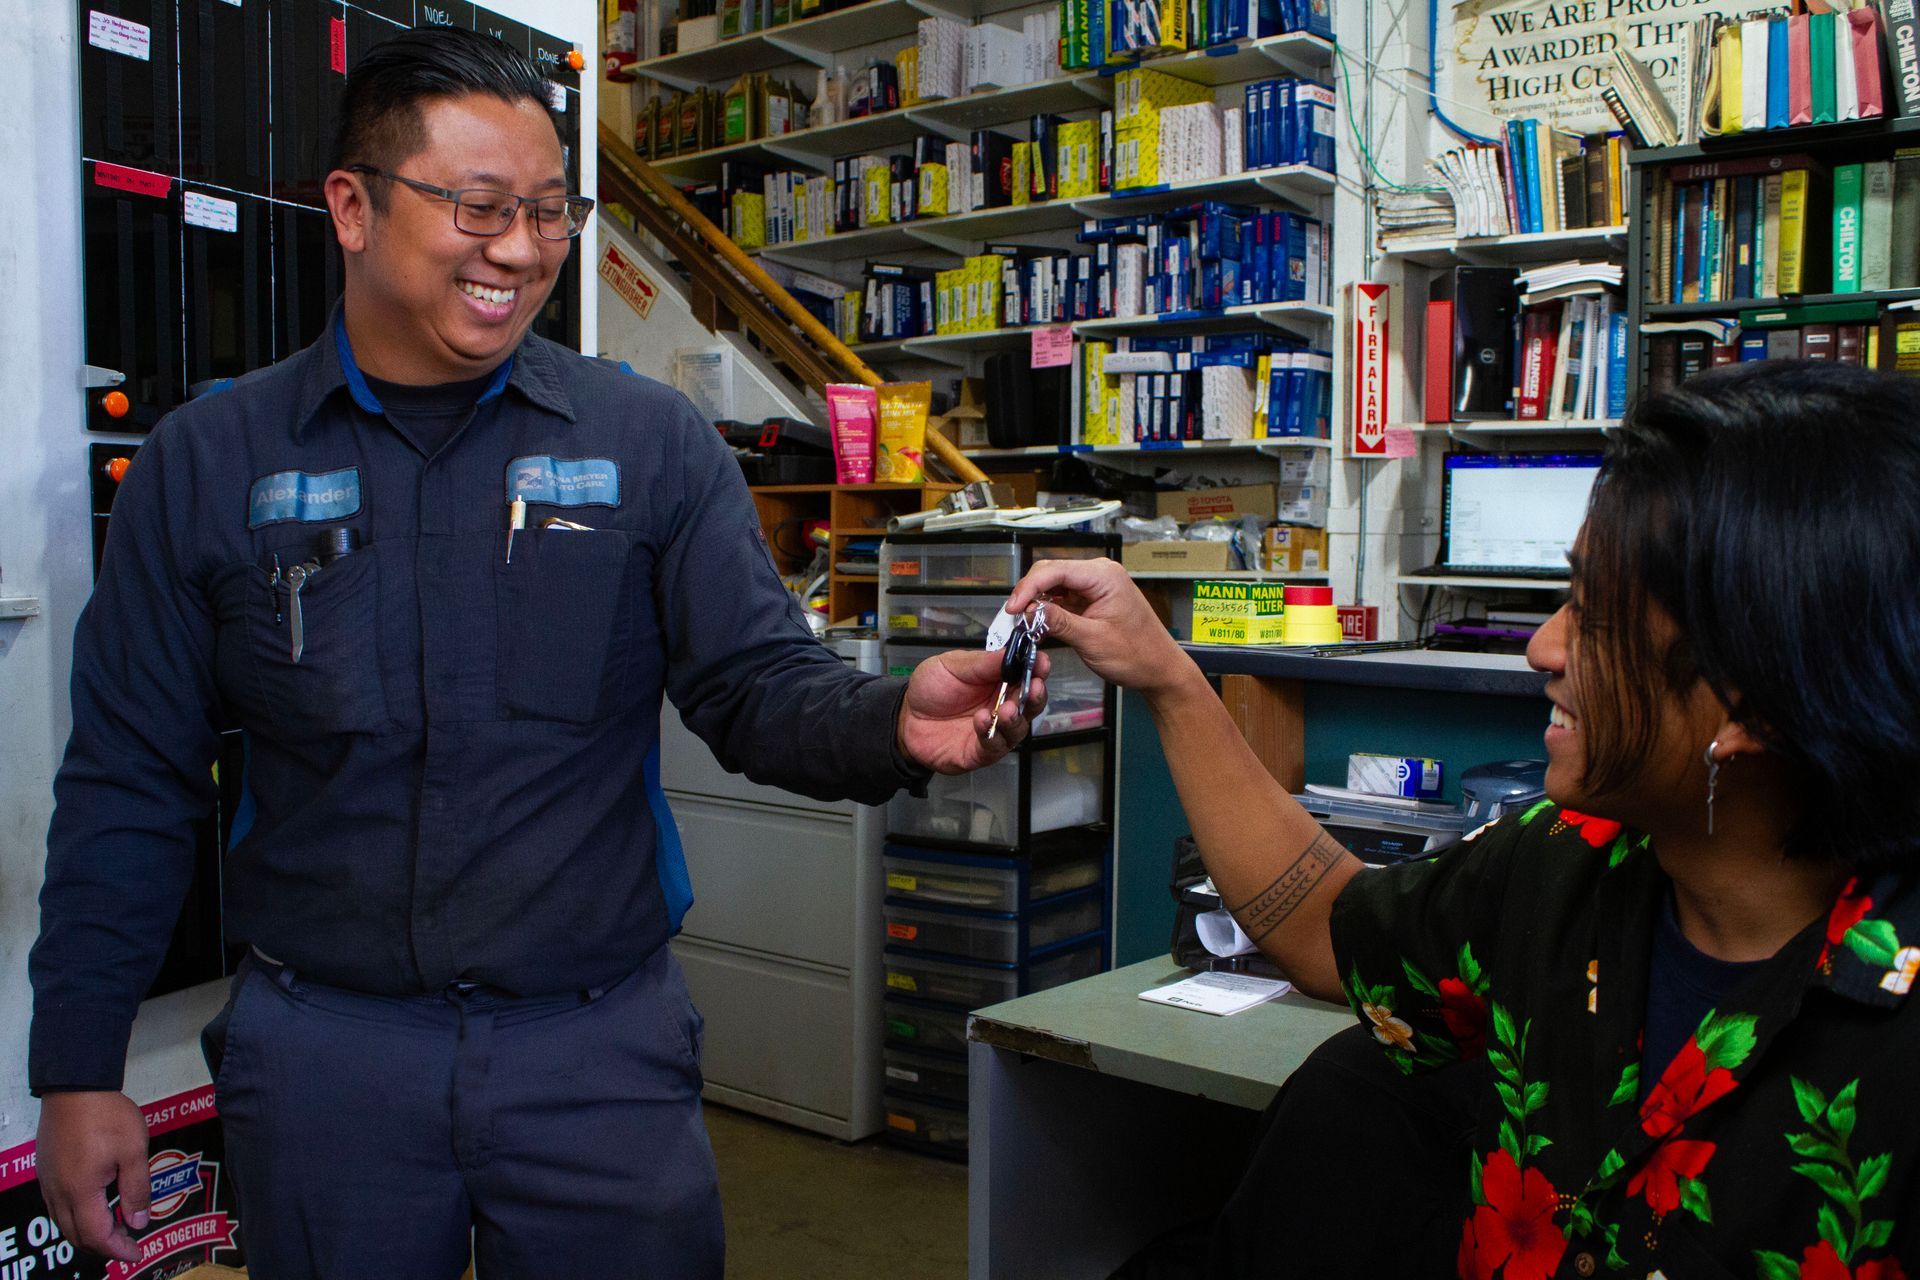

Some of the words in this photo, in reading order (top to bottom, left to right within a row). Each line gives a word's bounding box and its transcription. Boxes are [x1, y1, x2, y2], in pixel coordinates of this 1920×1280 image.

[424, 5, 453, 26] NOEL
[1490, 10, 1535, 36] WE
[1541, 2, 1596, 29] ARE
[1605, 0, 1710, 19] PROU
[538, 48, 560, 65] DONE
[1479, 32, 1618, 70] AWARDED
[1896, 24, 1920, 103] CHILTON
[1488, 73, 1563, 101] HIGH
[1838, 206, 1855, 281] CHILTON
[1368, 305, 1377, 361] FIRE
[1529, 338, 1542, 399] GRAINGER
[1365, 366, 1377, 436] ALARM
[545, 470, 571, 483] DNA
[549, 481, 574, 491] ATO
[1197, 585, 1247, 599] MANN
[1252, 587, 1284, 600] MANN
[12, 1152, 37, 1174] THE
[180, 1093, 216, 1115] CANC
[150, 1166, 194, 1193] CHNET
[1, 1253, 36, 1280] UP
[43, 1240, 74, 1271] TO
[132, 1238, 164, 1267] ARS
[165, 1219, 217, 1248] TOGETHER
